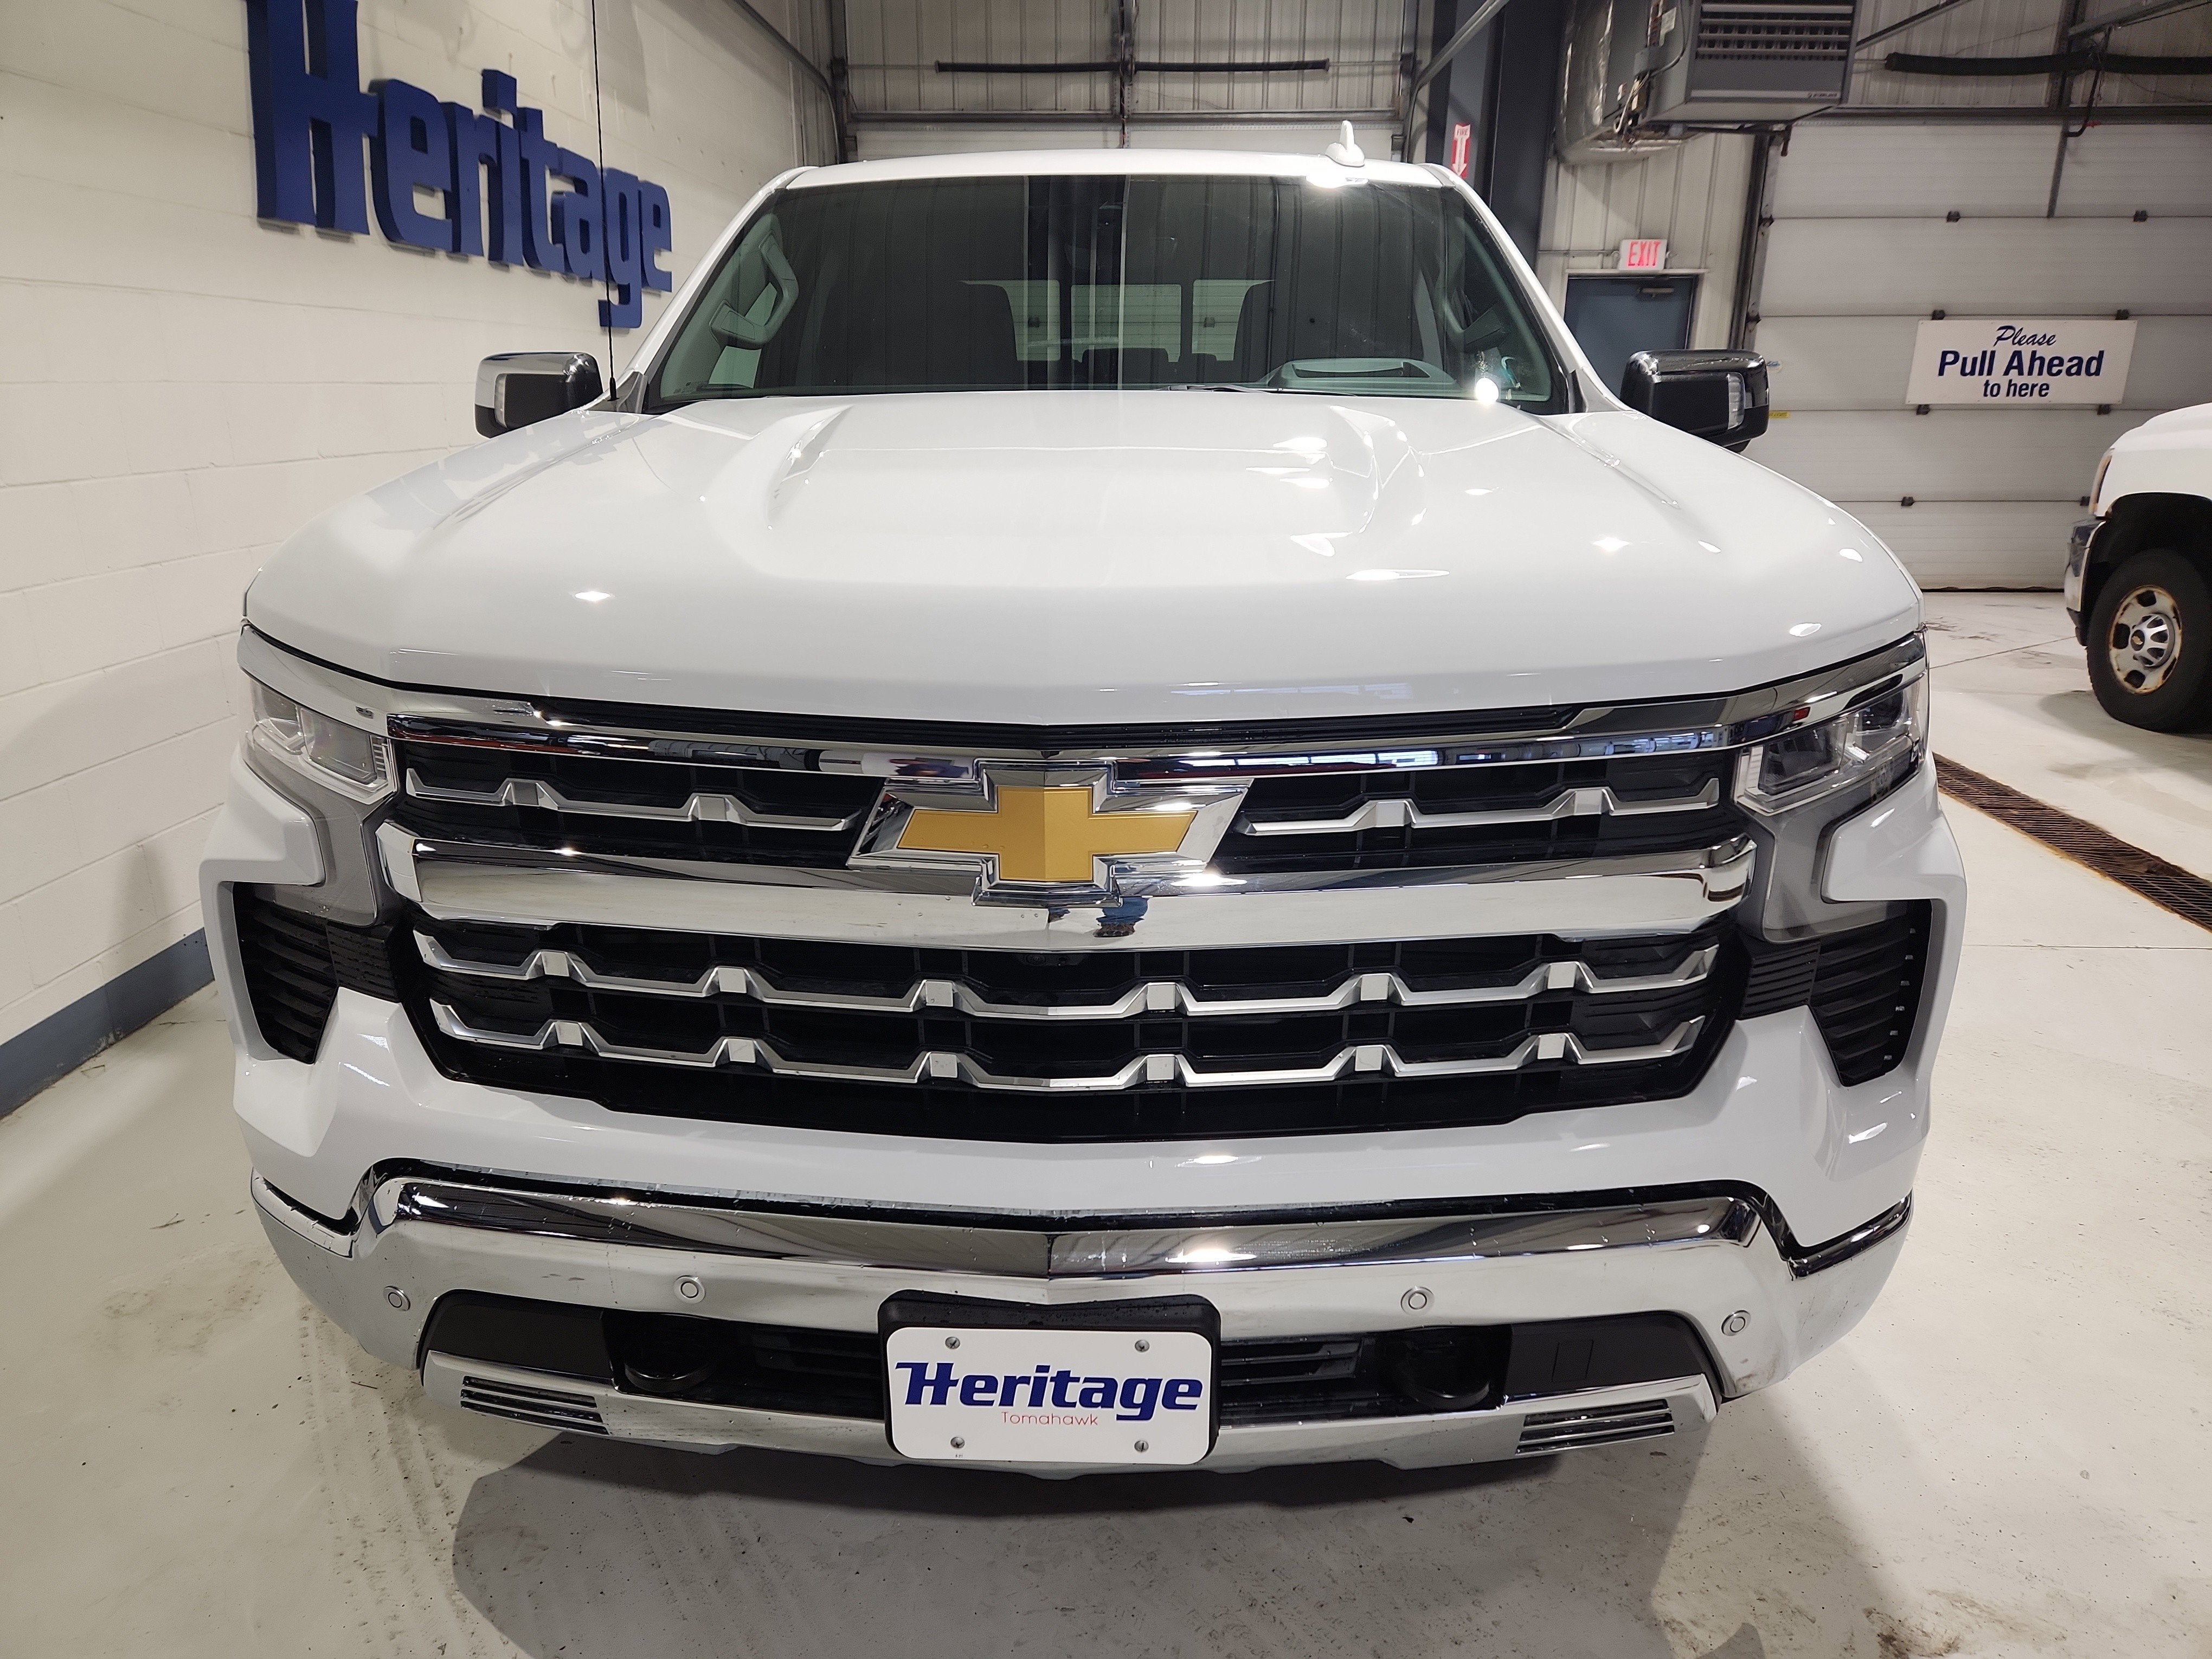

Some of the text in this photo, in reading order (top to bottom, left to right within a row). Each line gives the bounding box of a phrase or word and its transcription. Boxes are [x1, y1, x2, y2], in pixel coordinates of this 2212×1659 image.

[247, 0, 672, 329] Heritage
[1628, 240, 1661, 266] EXIT
[1993, 325, 2057, 346] Please
[1938, 350, 2105, 377] Pull Ahead
[1983, 379, 2050, 397] to here
[895, 1362, 1203, 1421] Heritage
[1001, 1411, 1098, 1426] Tomahawk
